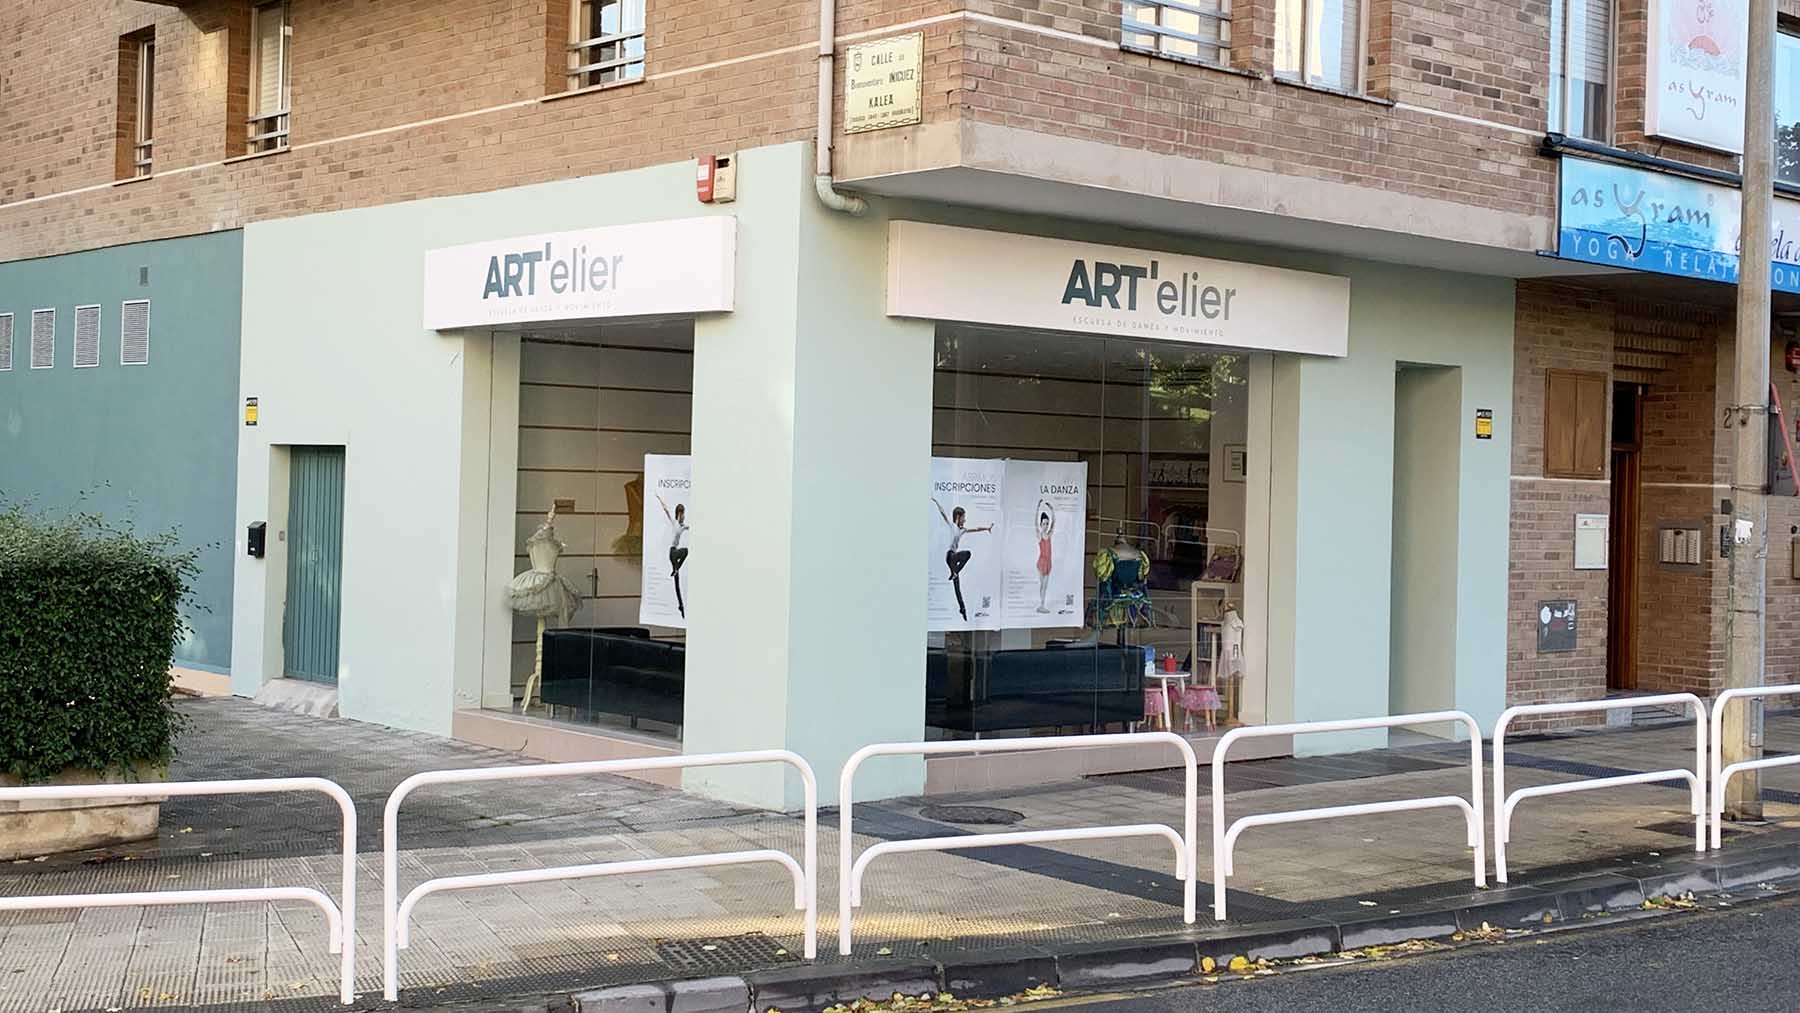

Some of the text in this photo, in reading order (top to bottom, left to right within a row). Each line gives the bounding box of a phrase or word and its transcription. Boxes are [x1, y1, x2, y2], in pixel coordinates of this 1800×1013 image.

[871, 52, 893, 66] CALLE
[869, 94, 894, 108] KALEA
[1072, 316, 1112, 327] ESCUELA
[1117, 320, 1127, 328] DE
[1132, 322, 1160, 331] DANZA
[1172, 326, 1224, 337] MOVIMIENTO
[934, 481, 996, 493] INSCRIPCIONES
[1040, 484, 1079, 495] LA DANZA
